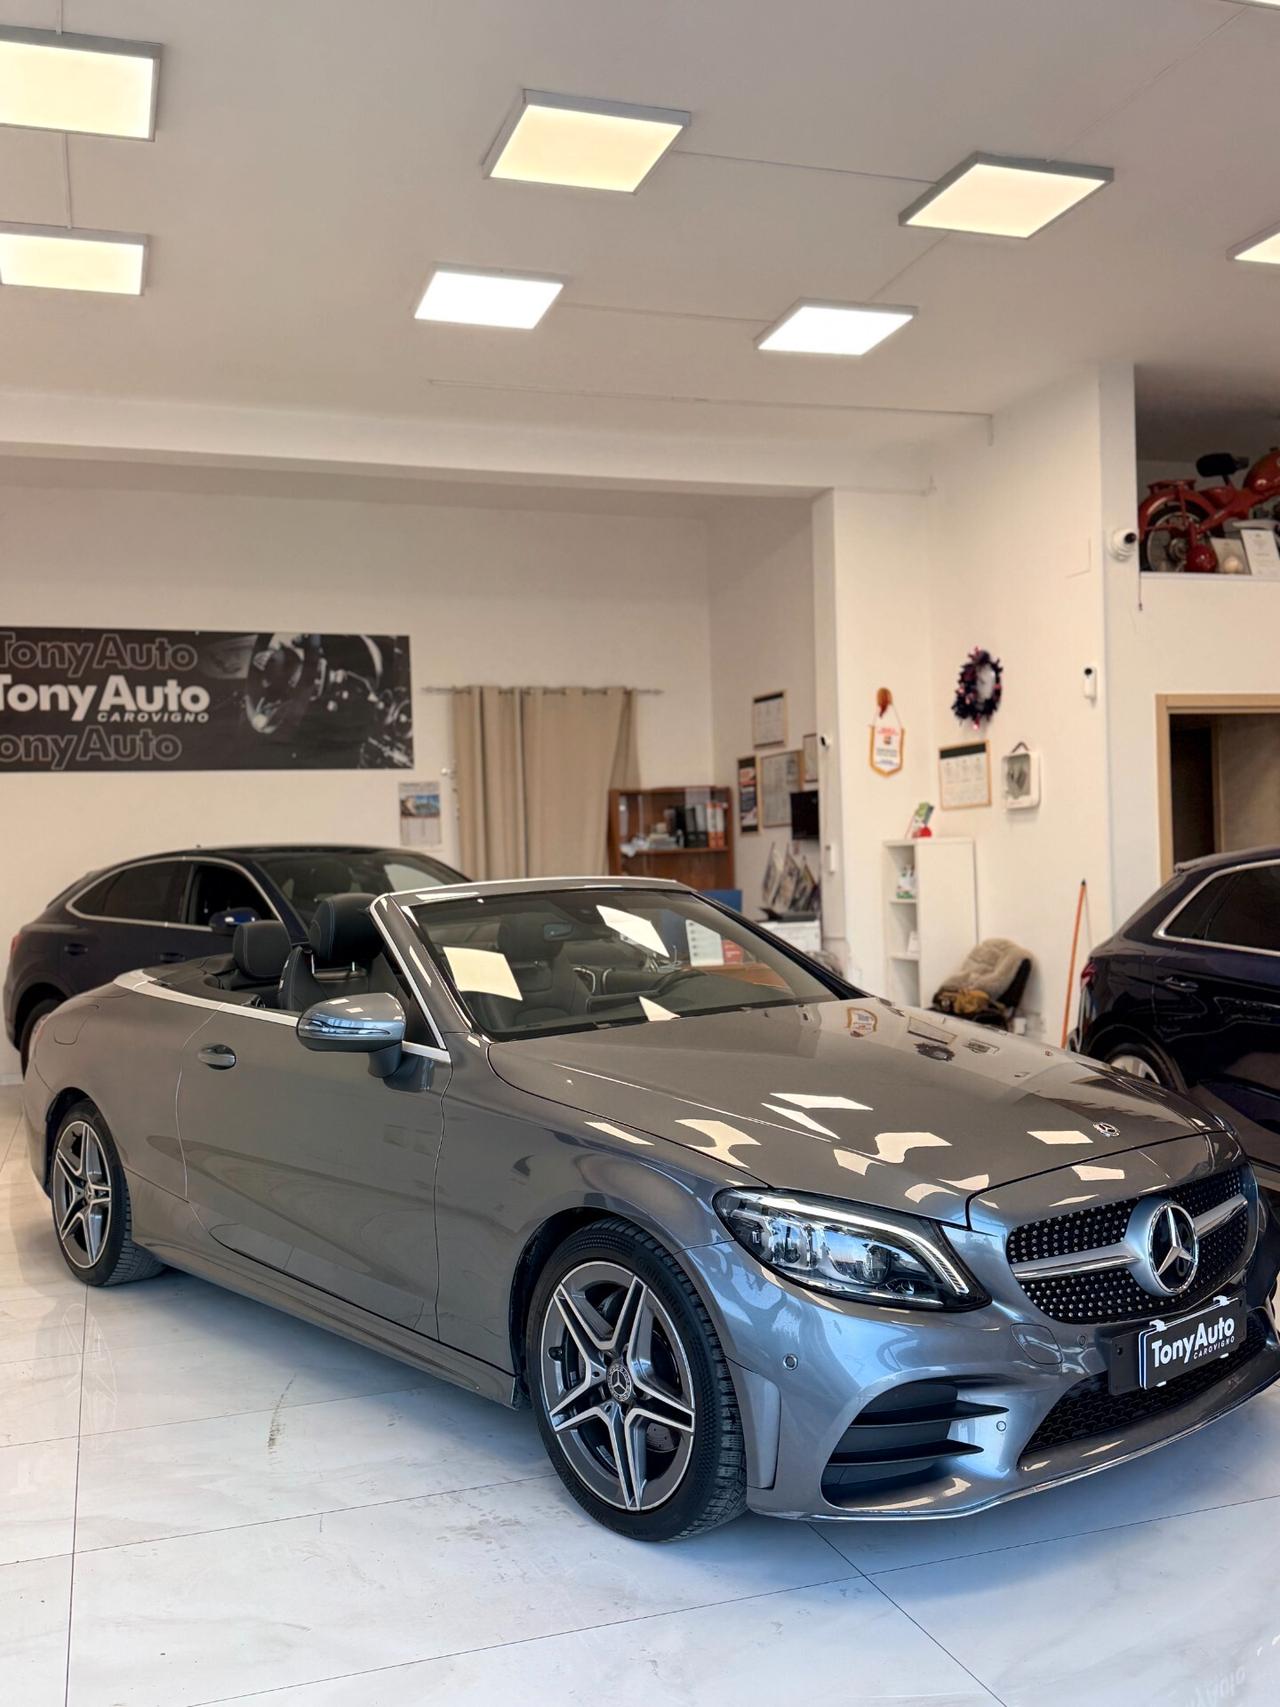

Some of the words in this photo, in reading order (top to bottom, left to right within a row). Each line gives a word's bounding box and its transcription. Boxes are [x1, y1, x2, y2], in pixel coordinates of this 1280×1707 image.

[97, 712, 210, 723] CAROVIGNO
[1151, 1317, 1235, 1368] TonyAuto
[1193, 1335, 1235, 1360] CAROVIGNO
